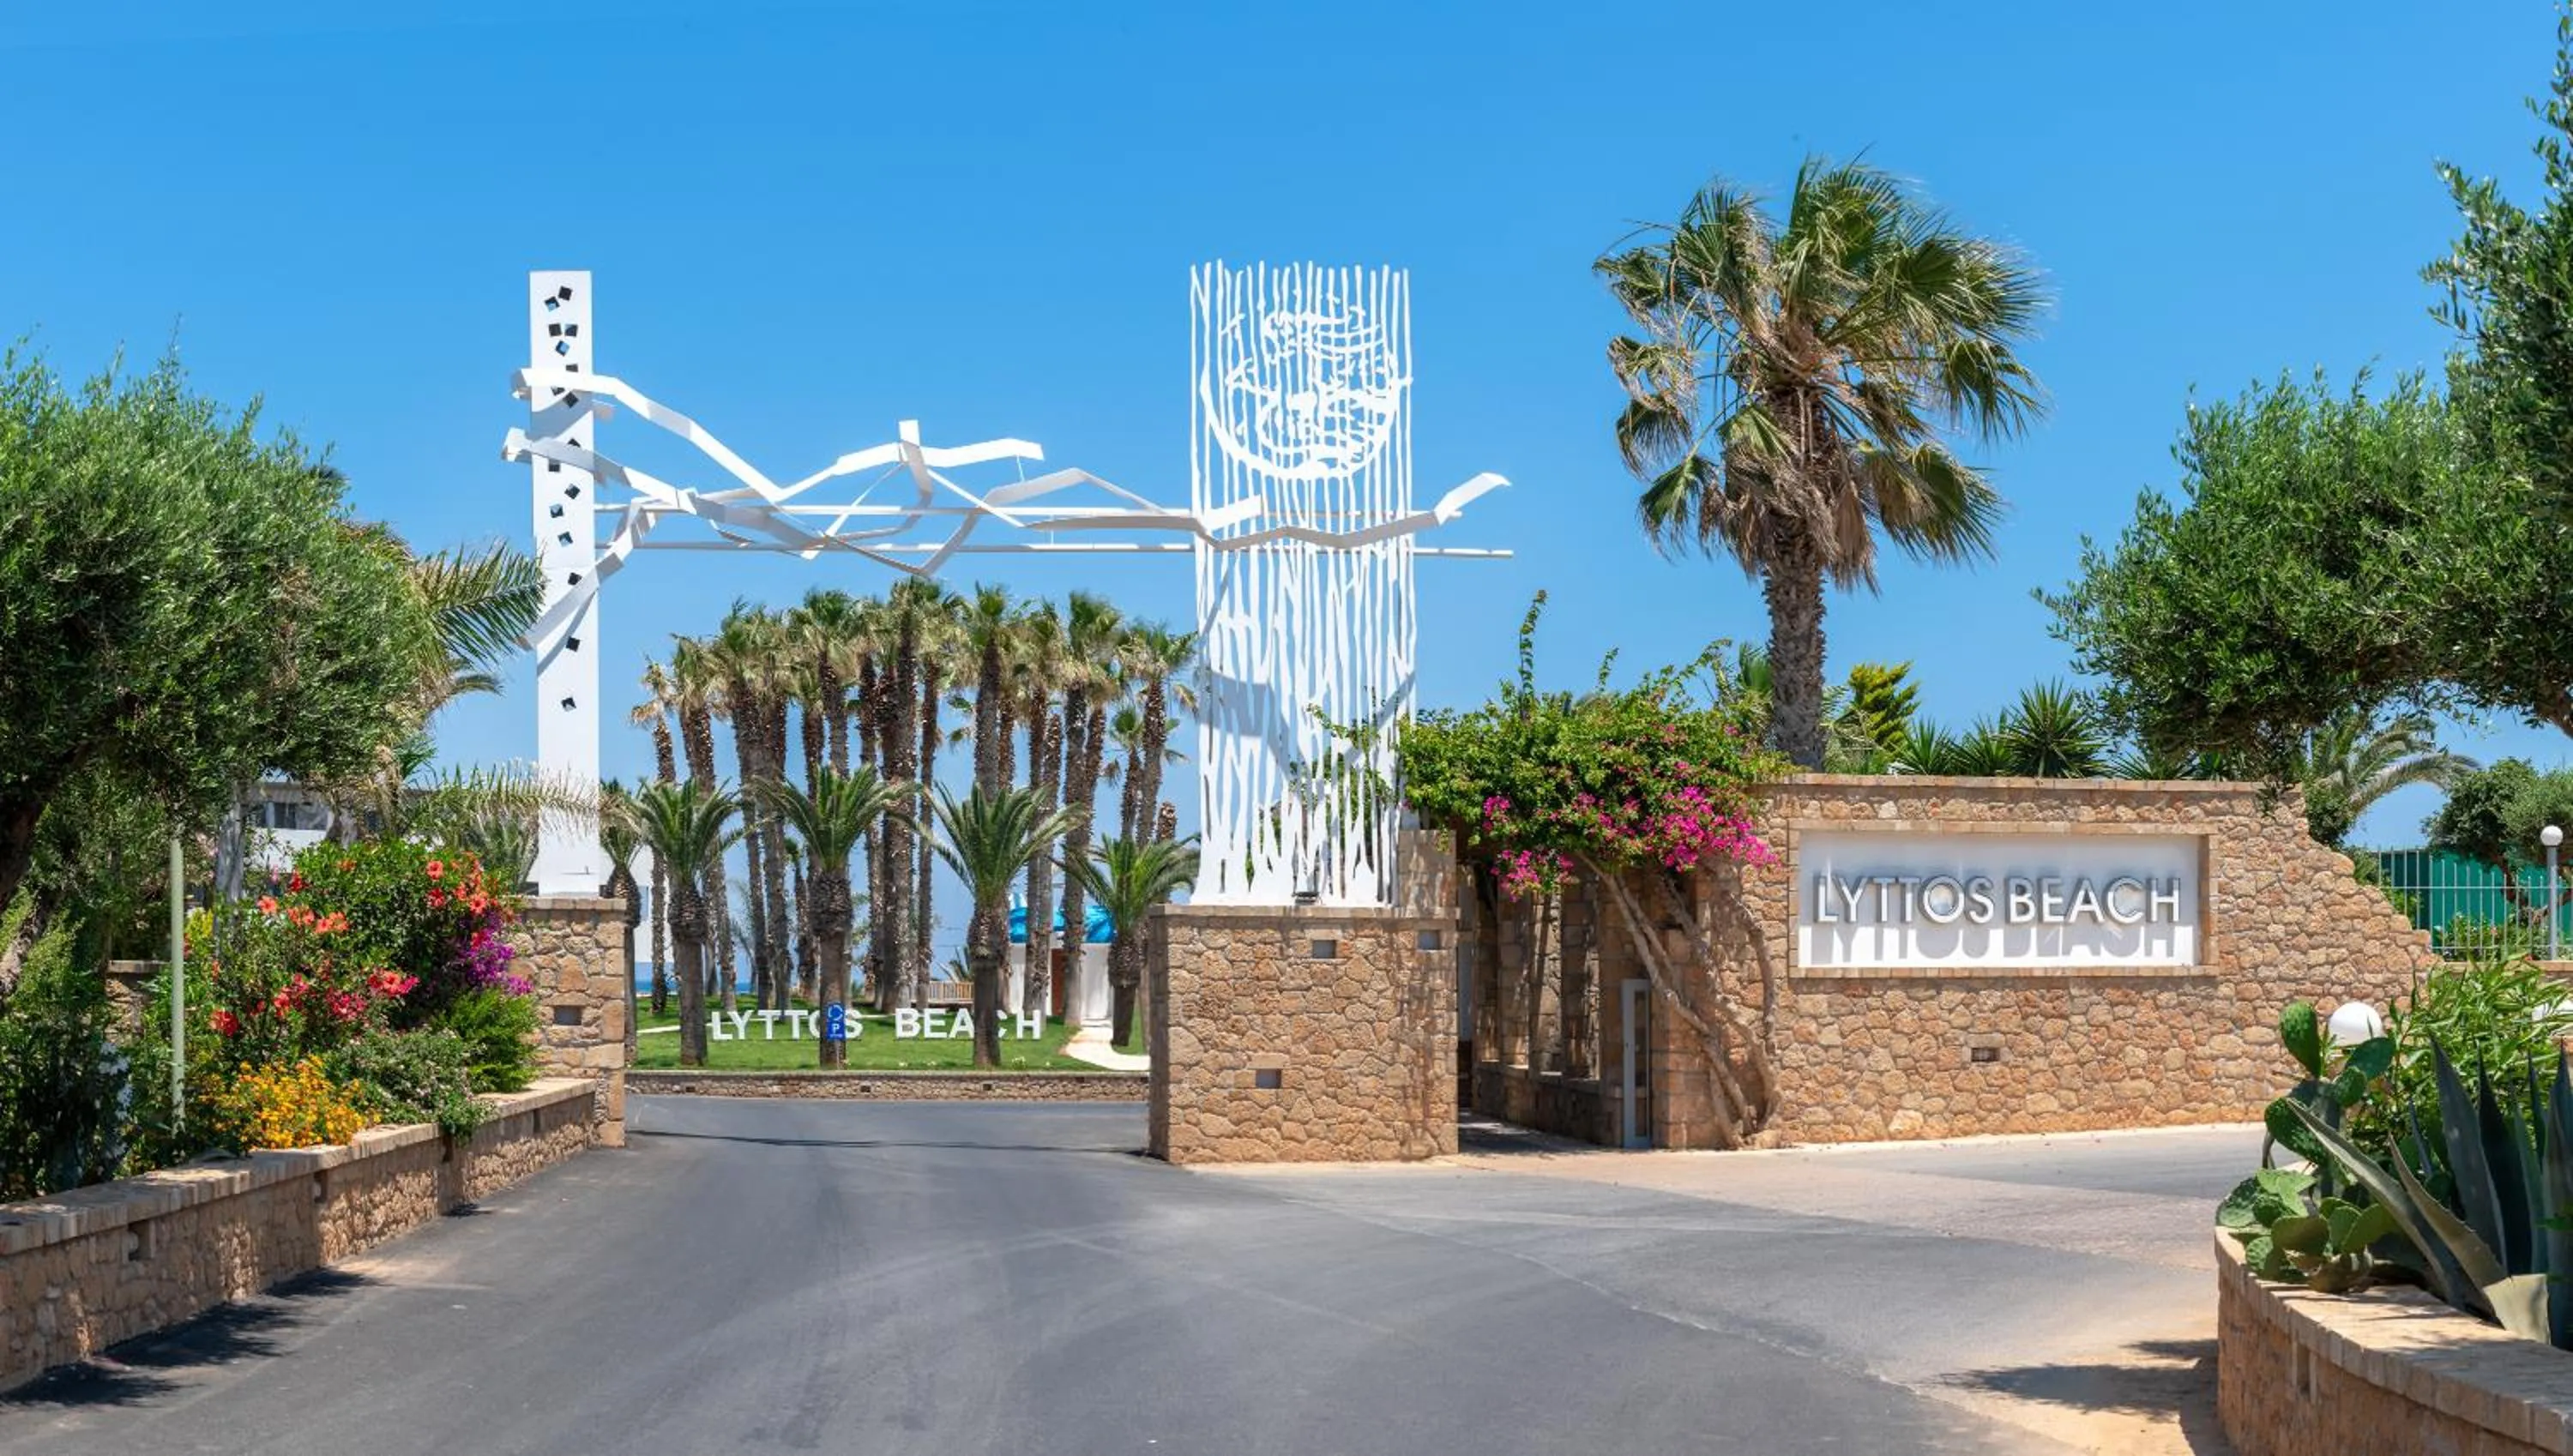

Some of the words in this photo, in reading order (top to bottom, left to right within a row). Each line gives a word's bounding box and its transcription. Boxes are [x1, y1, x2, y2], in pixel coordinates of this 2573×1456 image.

[1814, 875, 1995, 924] LYTTOS
[2004, 875, 2180, 924] BEACH
[831, 1023, 841, 1034] P
[895, 1008, 1041, 1040] BEAH
